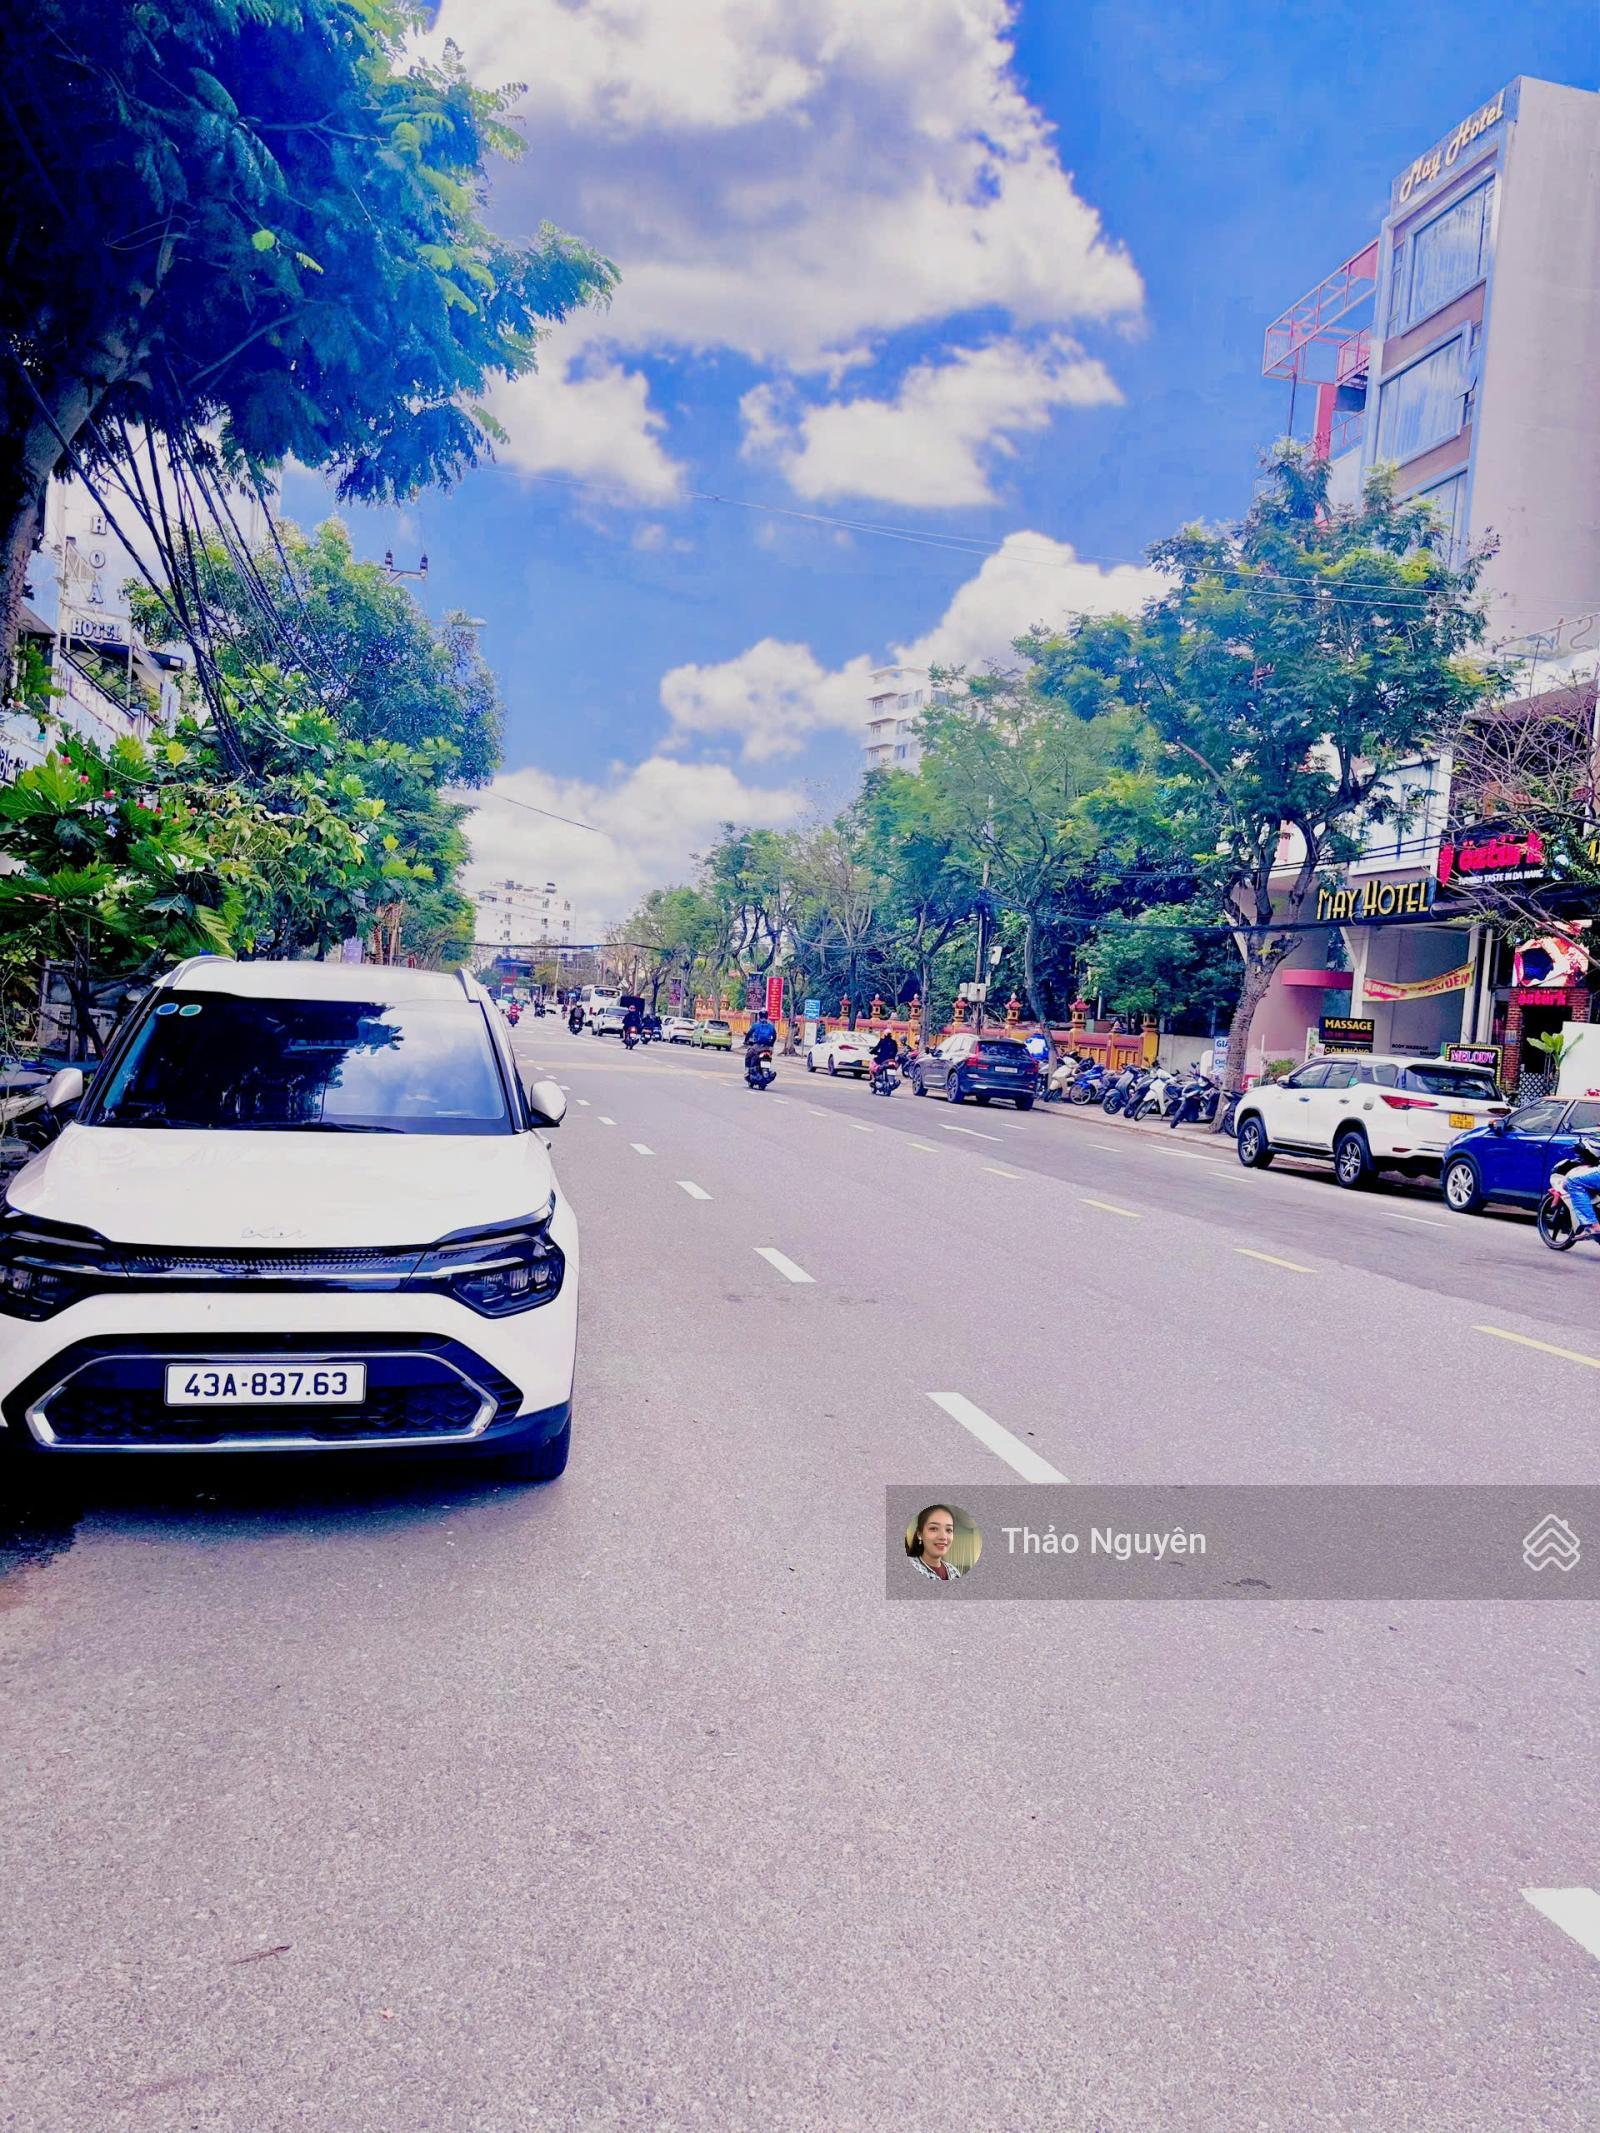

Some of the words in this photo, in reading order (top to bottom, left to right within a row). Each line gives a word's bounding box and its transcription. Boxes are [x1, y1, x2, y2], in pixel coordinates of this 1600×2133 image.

[1445, 89, 1505, 167] Hotel
[71, 617, 123, 642] HOTEL
[1484, 872, 1505, 883] TASTE
[1316, 888, 1359, 920] MAY
[1362, 880, 1429, 916] HOTEL
[1324, 1017, 1373, 1031] MASSAGE
[1450, 1050, 1496, 1064] MELODY
[184, 1371, 349, 1397] 43A-837.63
